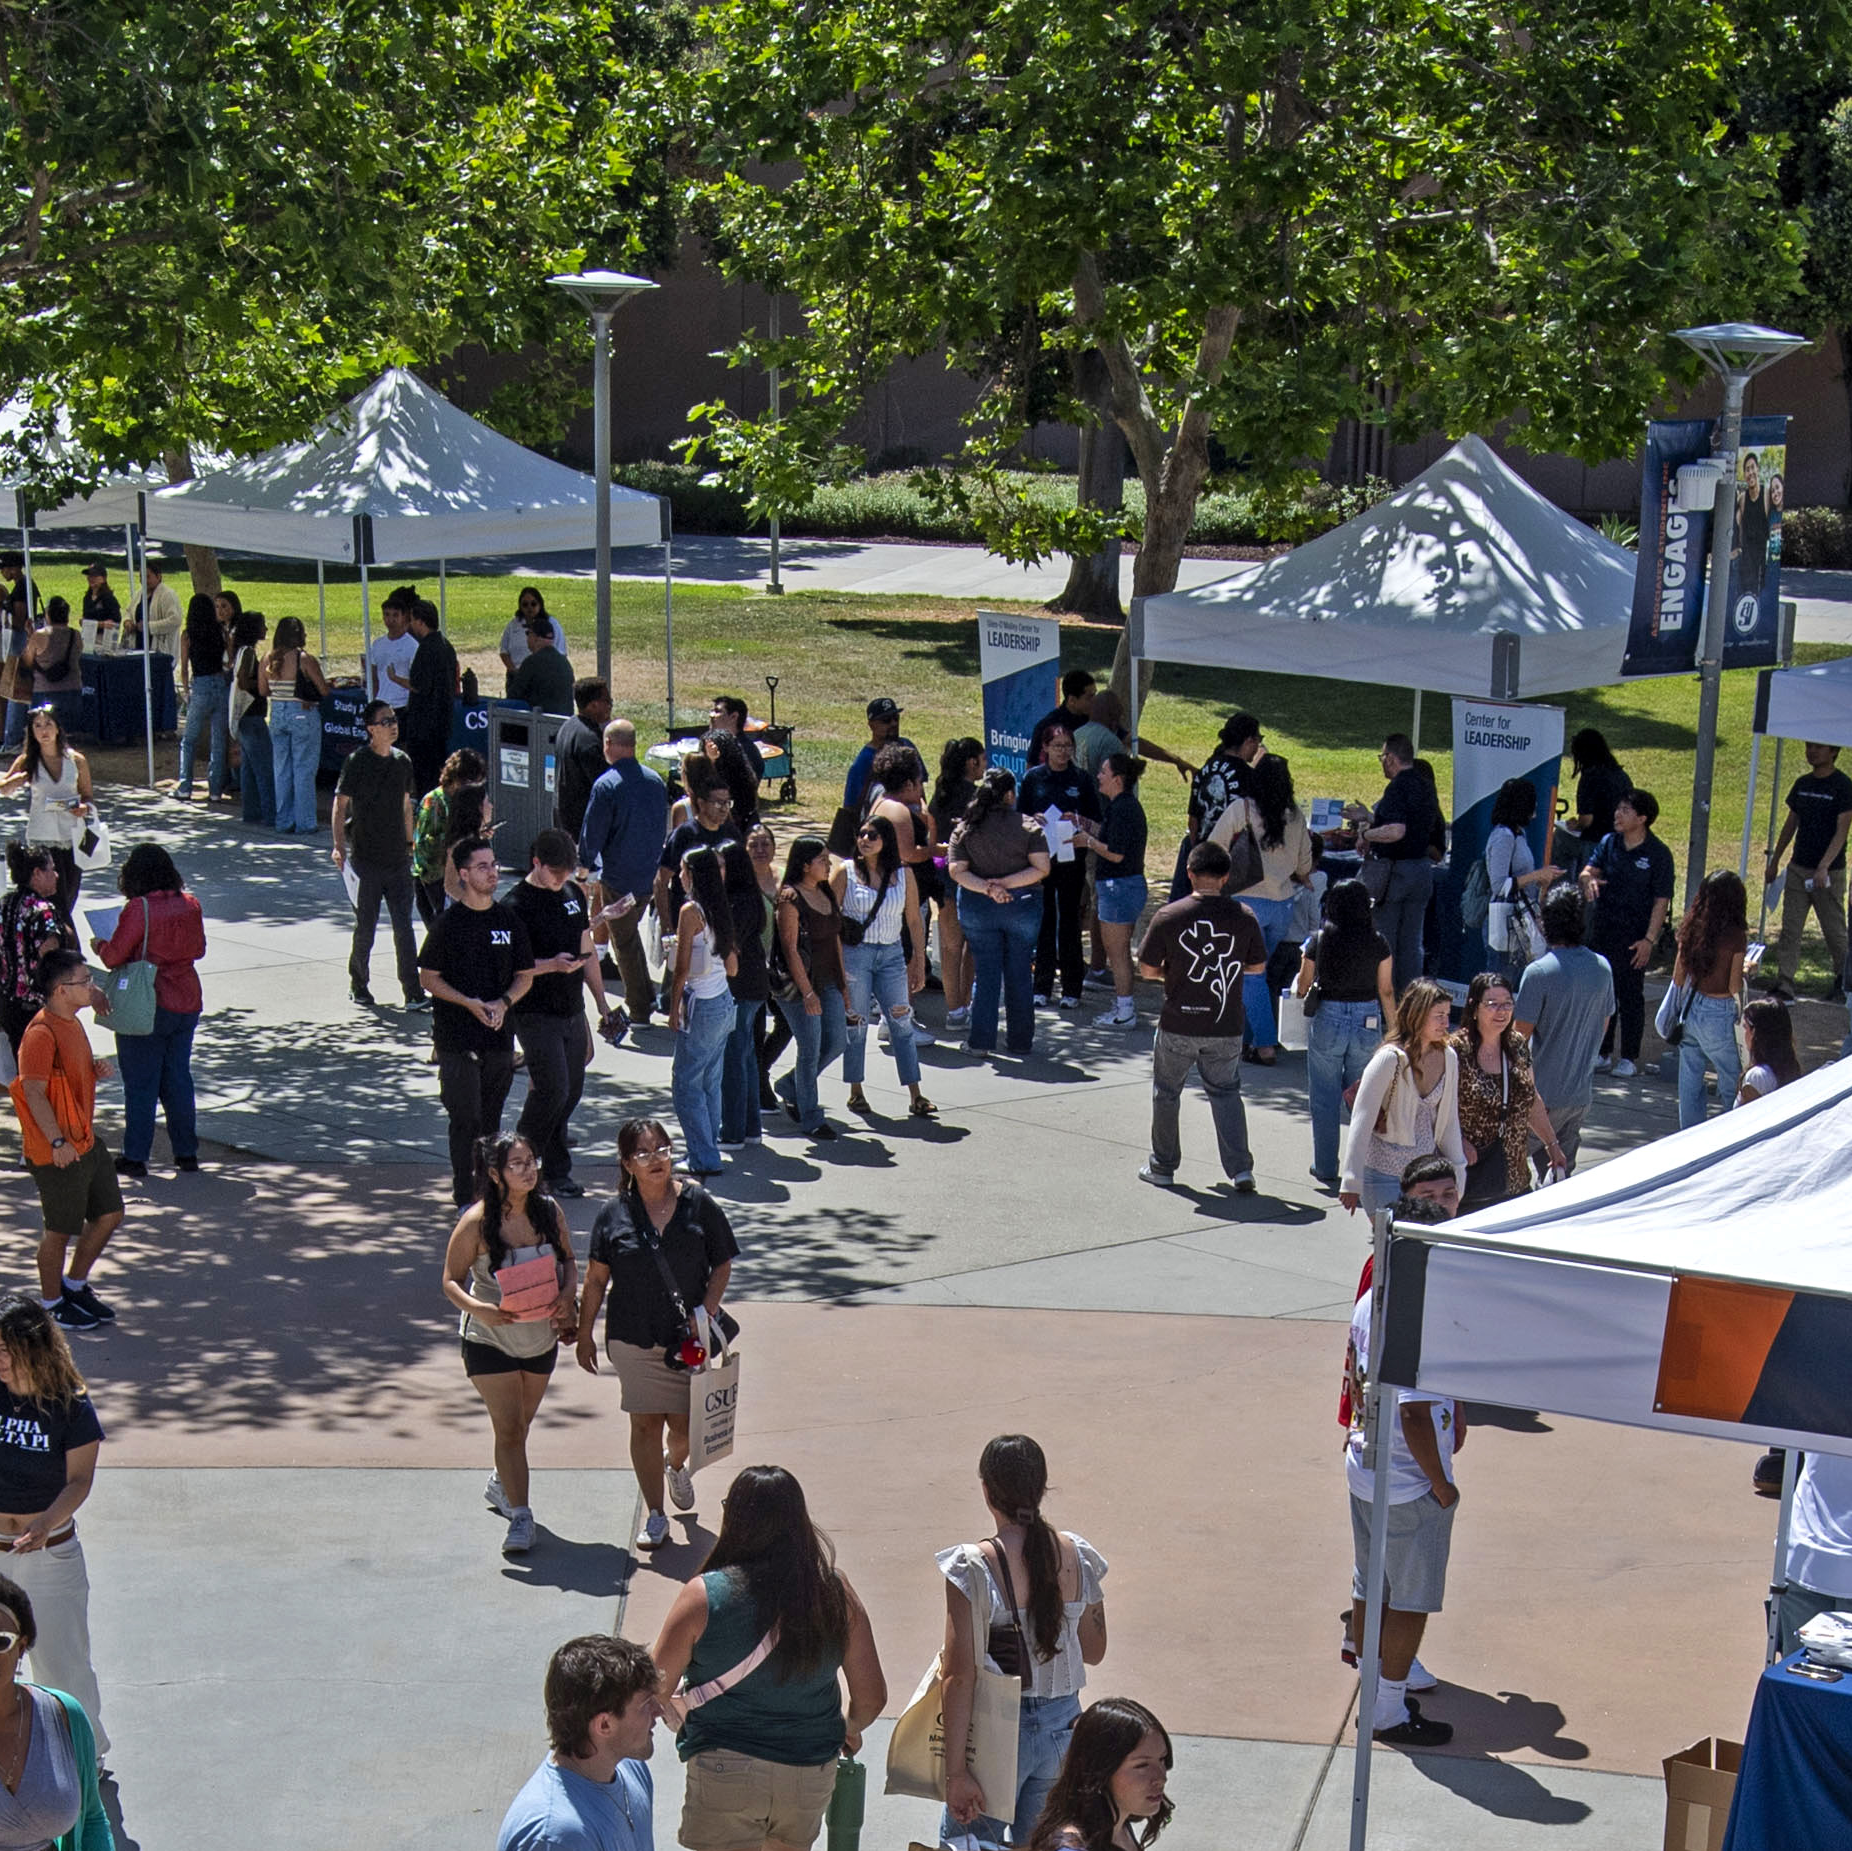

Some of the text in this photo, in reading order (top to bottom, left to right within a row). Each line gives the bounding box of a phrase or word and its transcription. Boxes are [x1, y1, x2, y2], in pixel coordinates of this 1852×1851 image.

[1651, 560, 1664, 638] ASSOCIATED
[1659, 490, 1668, 553] STUDENTS
[987, 630, 1041, 653] LEADERSHIP
[334, 699, 357, 714] Study
[324, 722, 350, 737] Global
[1465, 712, 1511, 730] Center for
[1464, 730, 1531, 752] LEADERSHIP
[705, 1382, 738, 1413] CSUF
[32, 1434, 49, 1448] PI
